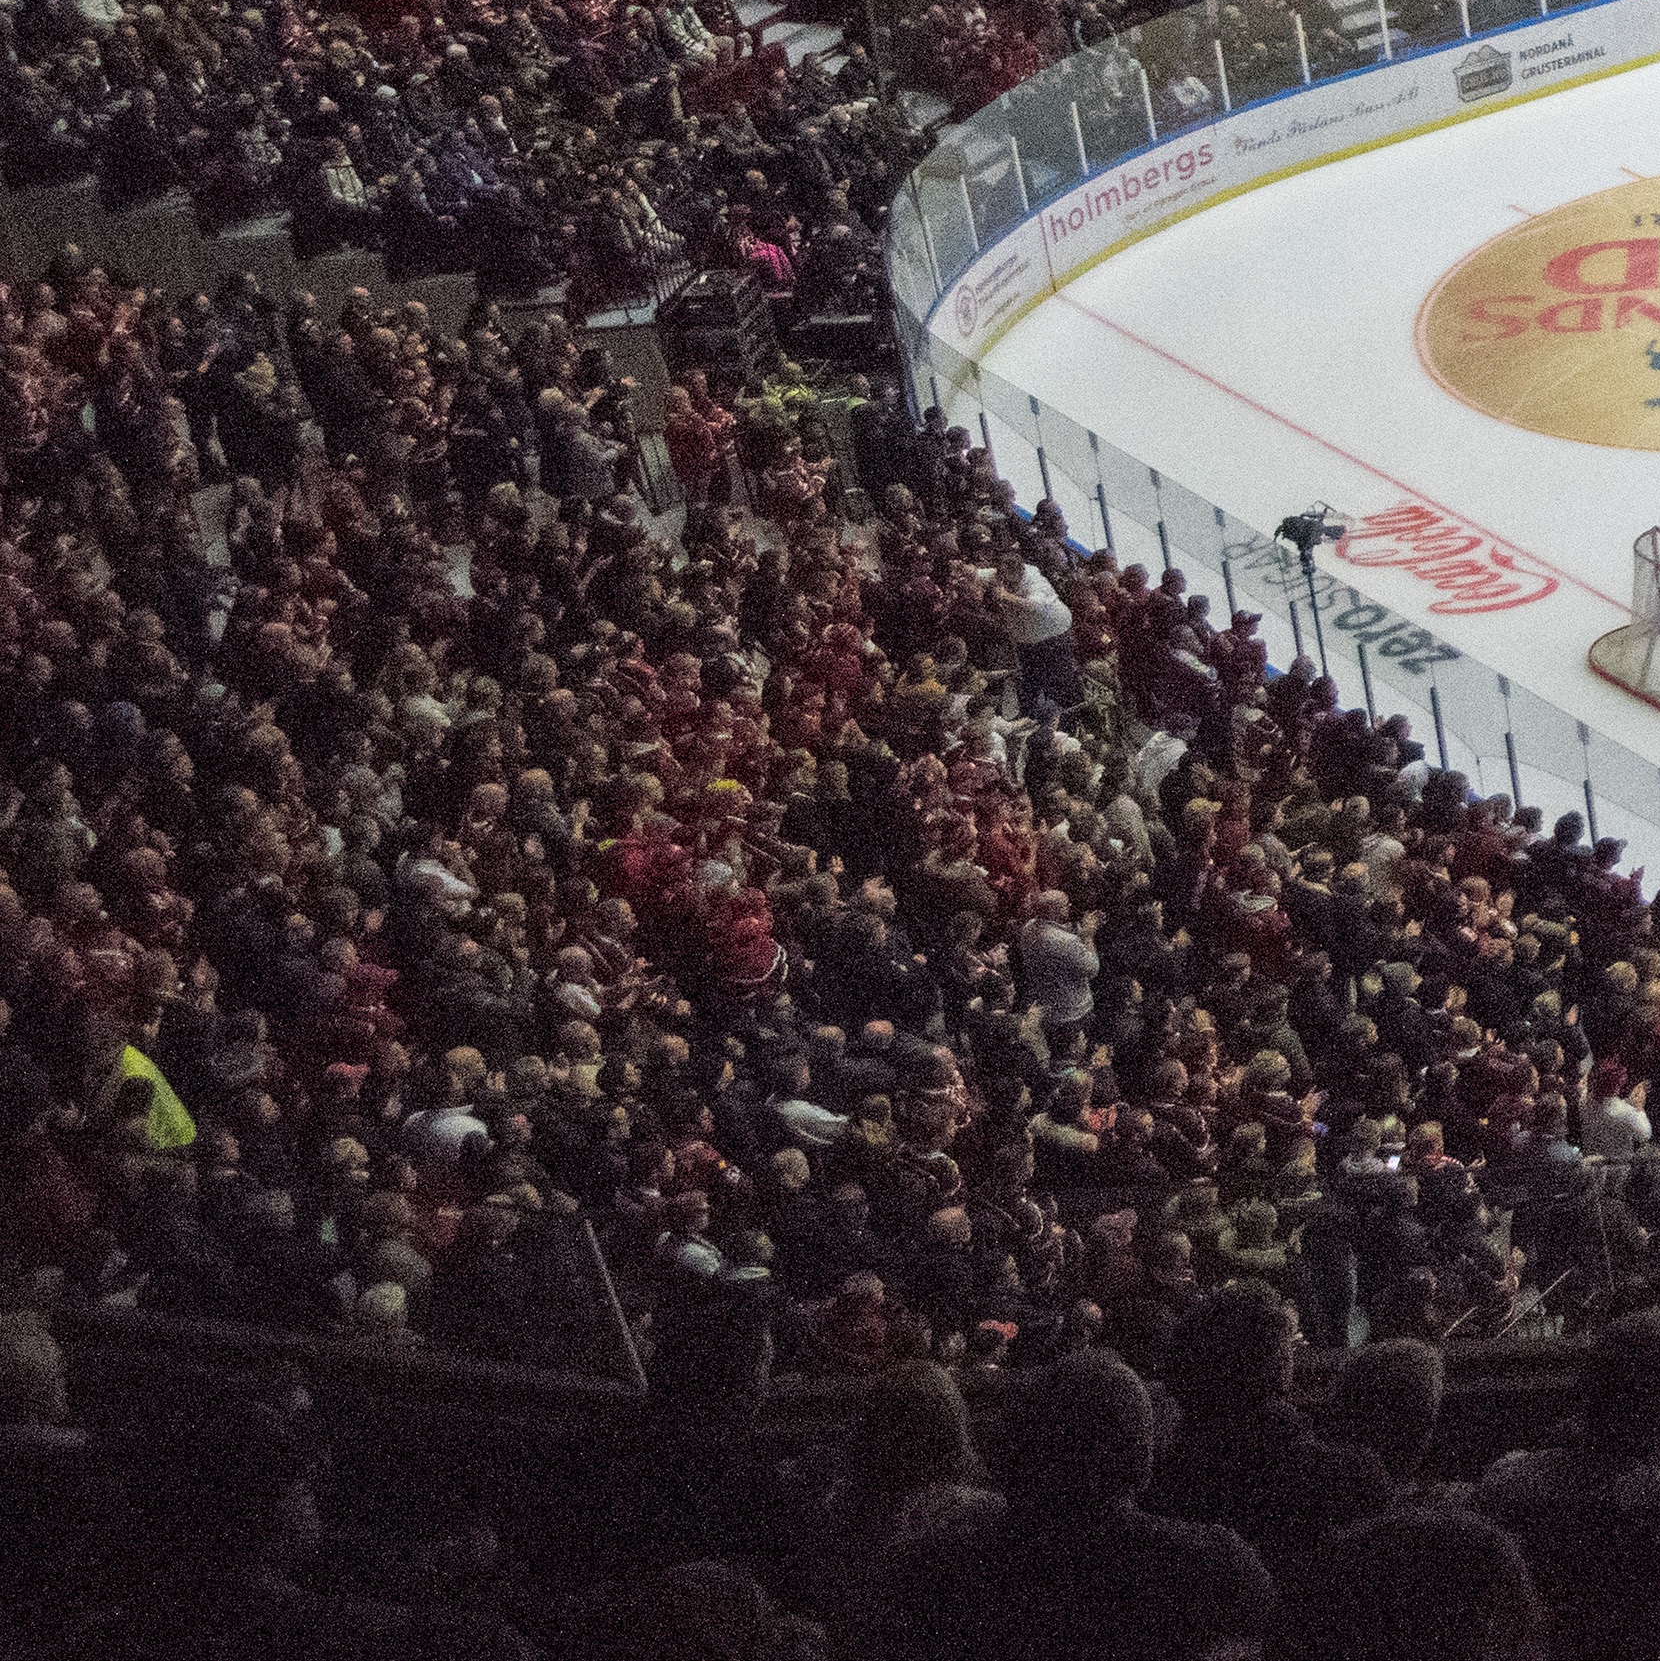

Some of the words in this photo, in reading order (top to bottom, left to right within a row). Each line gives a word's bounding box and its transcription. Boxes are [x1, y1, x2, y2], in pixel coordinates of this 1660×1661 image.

[1521, 46, 1607, 80] GRUSTERMINAL
[1048, 142, 1216, 244] holmbergs
[1335, 505, 1559, 615] Coca-Cola
[1333, 604, 1462, 674] zero
